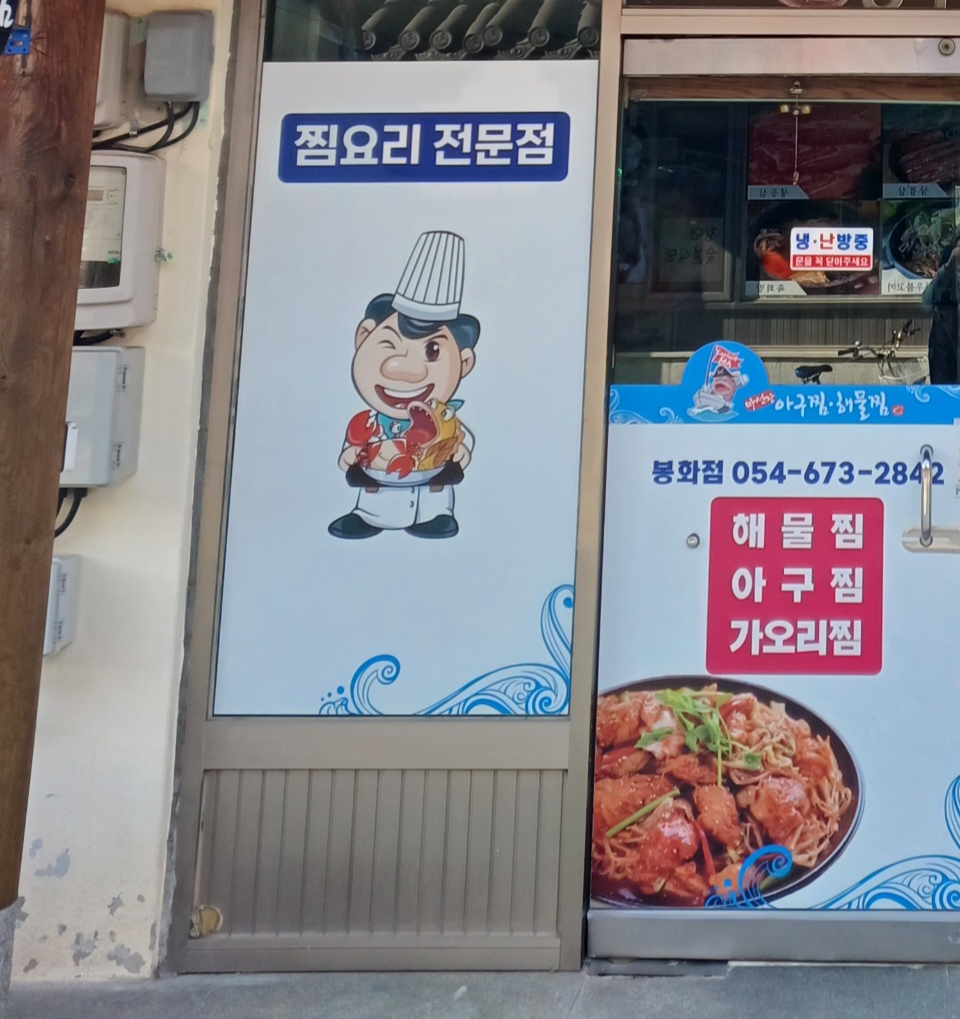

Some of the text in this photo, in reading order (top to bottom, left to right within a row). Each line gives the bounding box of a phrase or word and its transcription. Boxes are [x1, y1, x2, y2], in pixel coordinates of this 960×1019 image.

[294, 123, 555, 167] 찜요리 전문점
[796, 233, 868, 251] 냉·난방중
[795, 256, 812, 267] 문을
[652, 460, 944, 485] 봉화점 054-673-2842
[732, 513, 863, 549] 해물찜
[731, 567, 863, 603] 아구찜
[729, 619, 862, 656] 가오리찜
